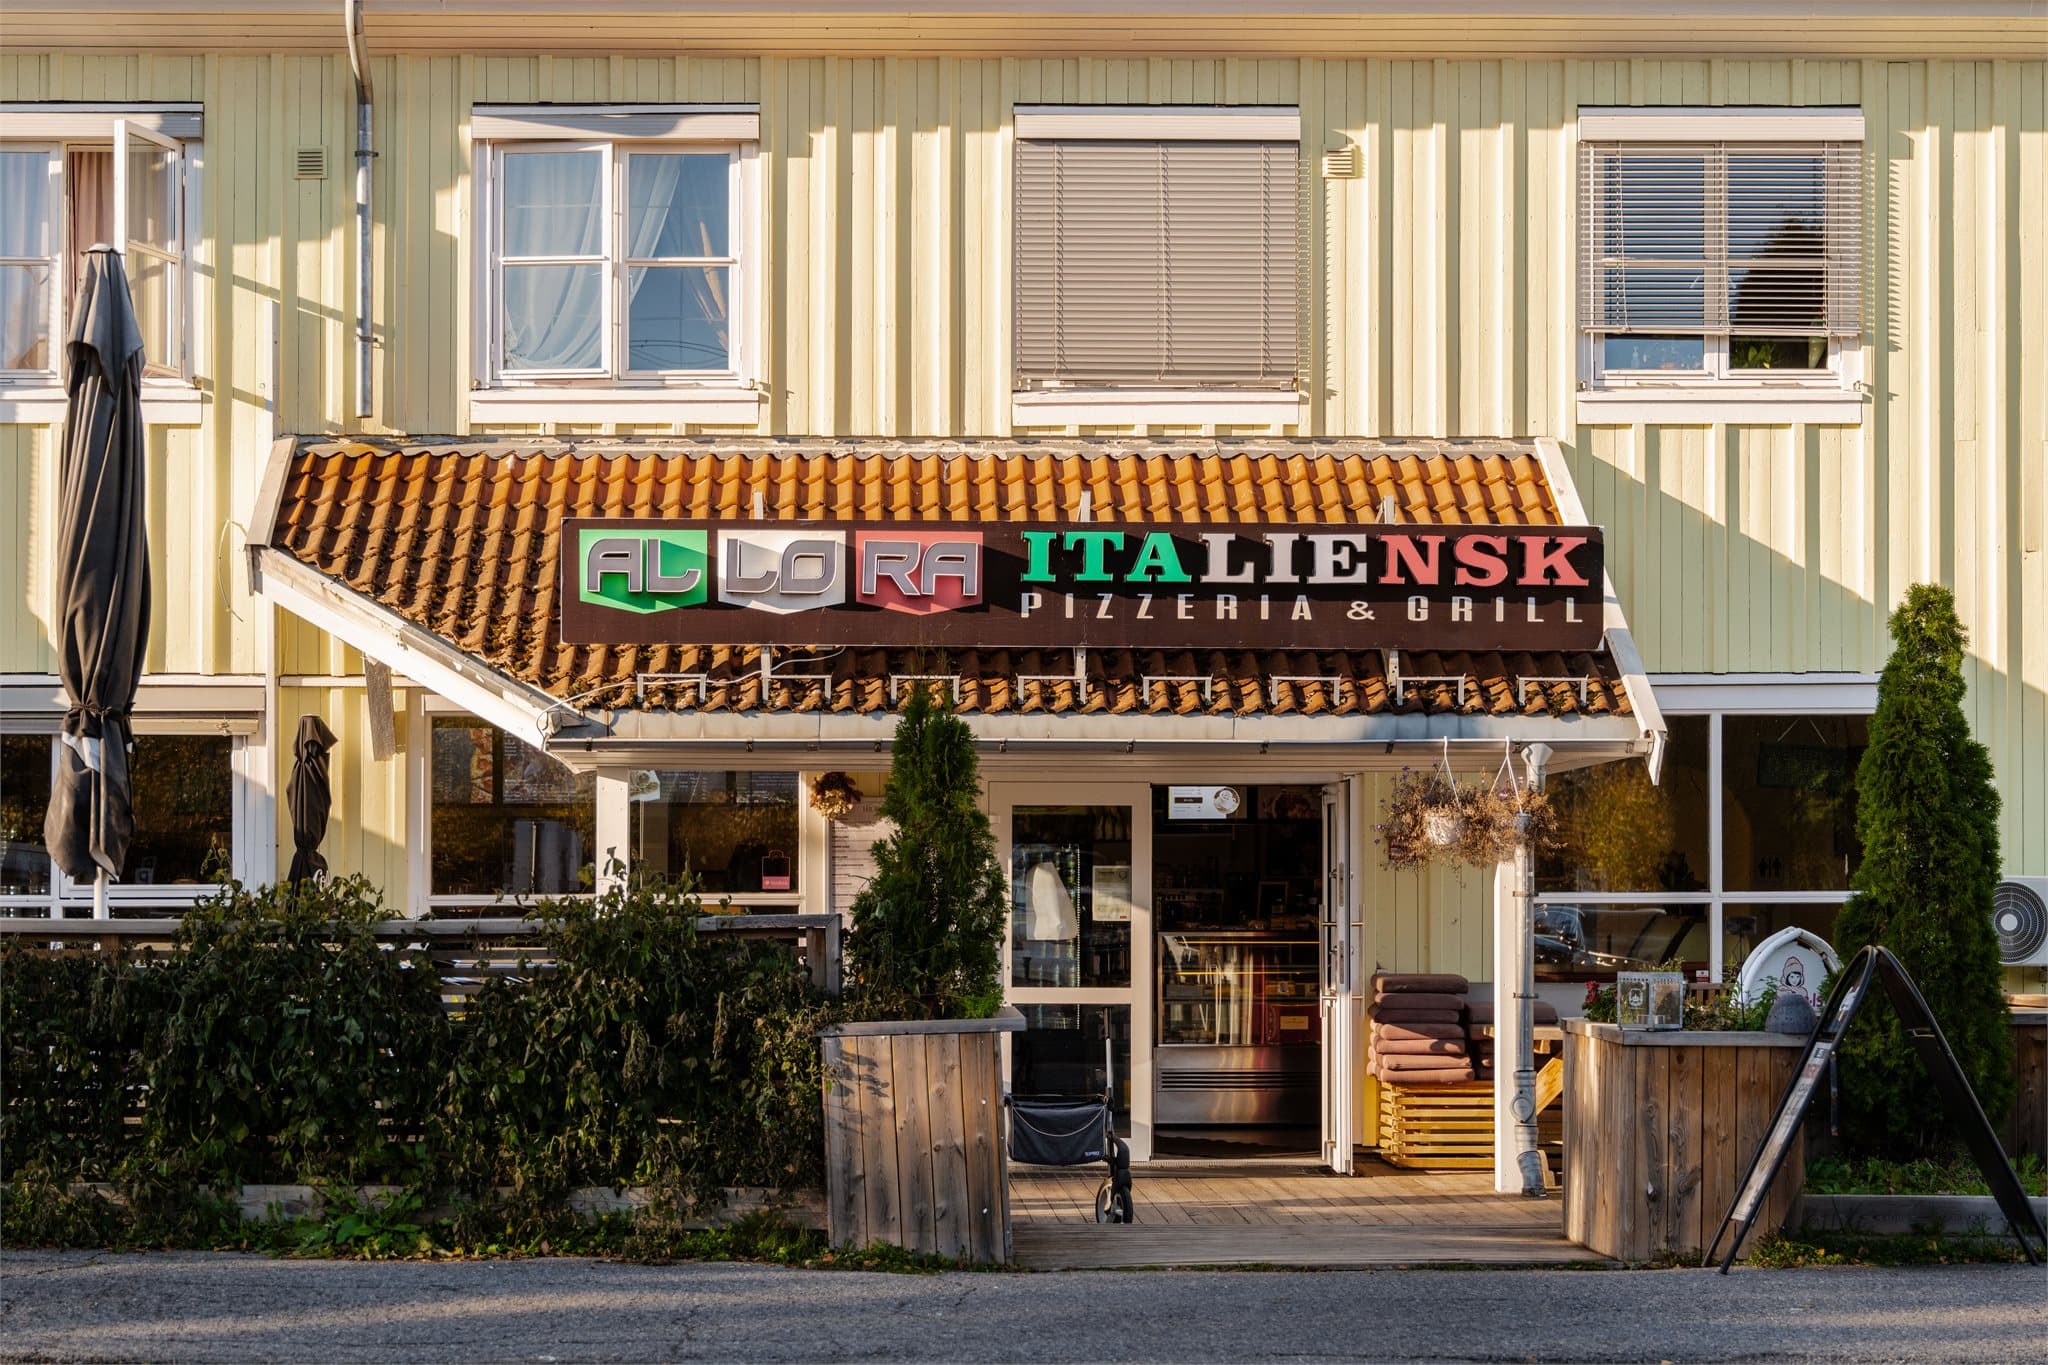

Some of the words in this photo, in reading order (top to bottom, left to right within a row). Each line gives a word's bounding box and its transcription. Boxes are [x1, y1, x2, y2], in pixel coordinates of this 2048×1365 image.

[1021, 531, 1590, 586] ITALIENSK
[1021, 593, 1312, 620] PIZZERIA
[1347, 600, 1375, 621] &
[1407, 595, 1583, 623] GRILL
